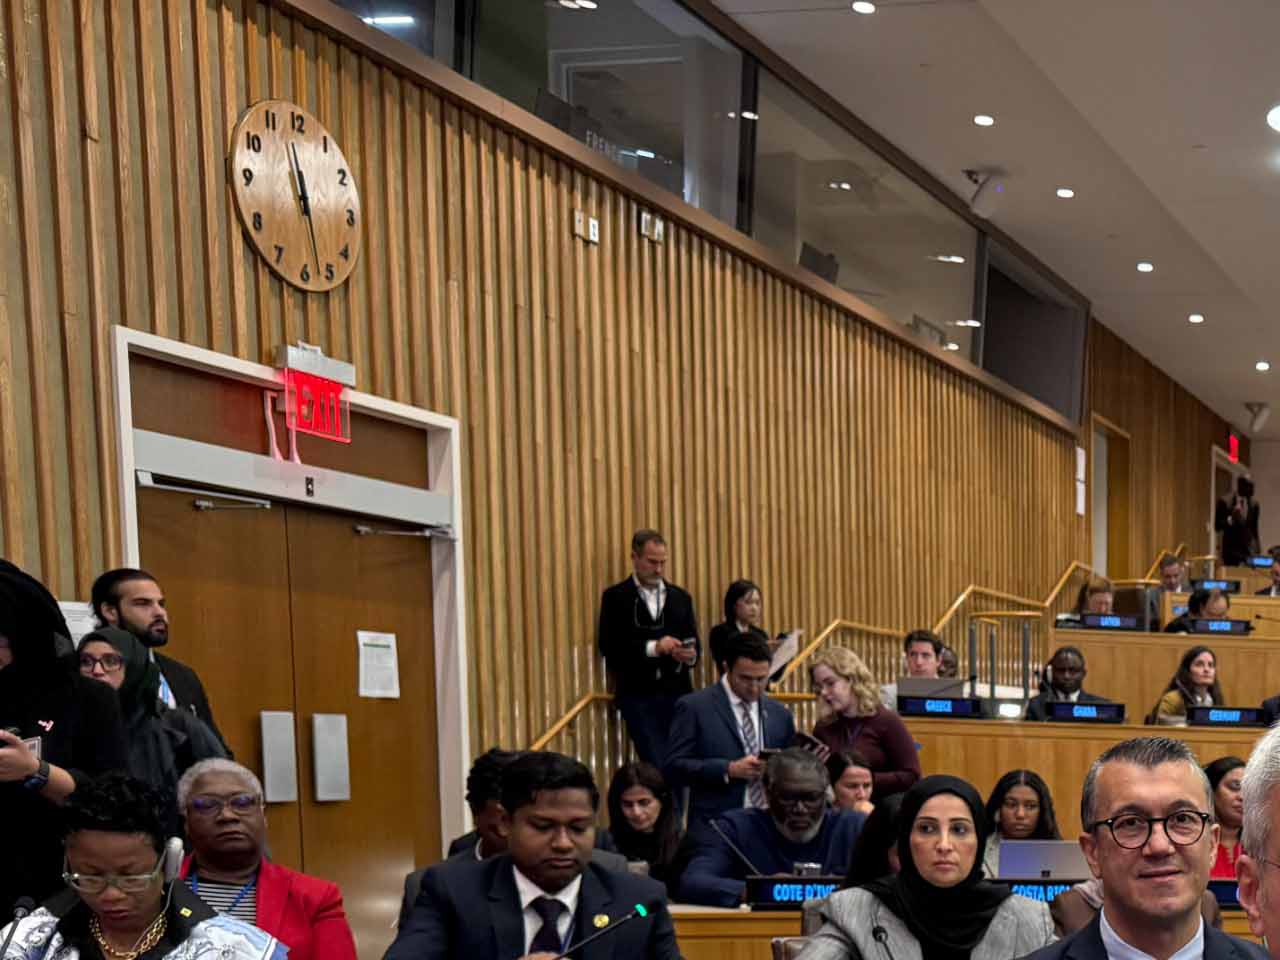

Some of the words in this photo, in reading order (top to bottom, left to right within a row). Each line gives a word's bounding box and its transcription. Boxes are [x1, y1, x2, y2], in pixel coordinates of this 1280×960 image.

[265, 109, 276, 131] 11
[291, 111, 305, 133] 12
[246, 131, 262, 153] 10
[242, 168, 253, 186] 9
[337, 168, 348, 186] 2
[252, 212, 262, 231] 8
[346, 209, 355, 227] 3
[274, 244, 284, 263] 7
[339, 243, 349, 262] 4
[300, 263, 310, 282] 6
[325, 263, 334, 281] 5
[296, 374, 343, 437] EXIT
[773, 883, 803, 902] COTE
